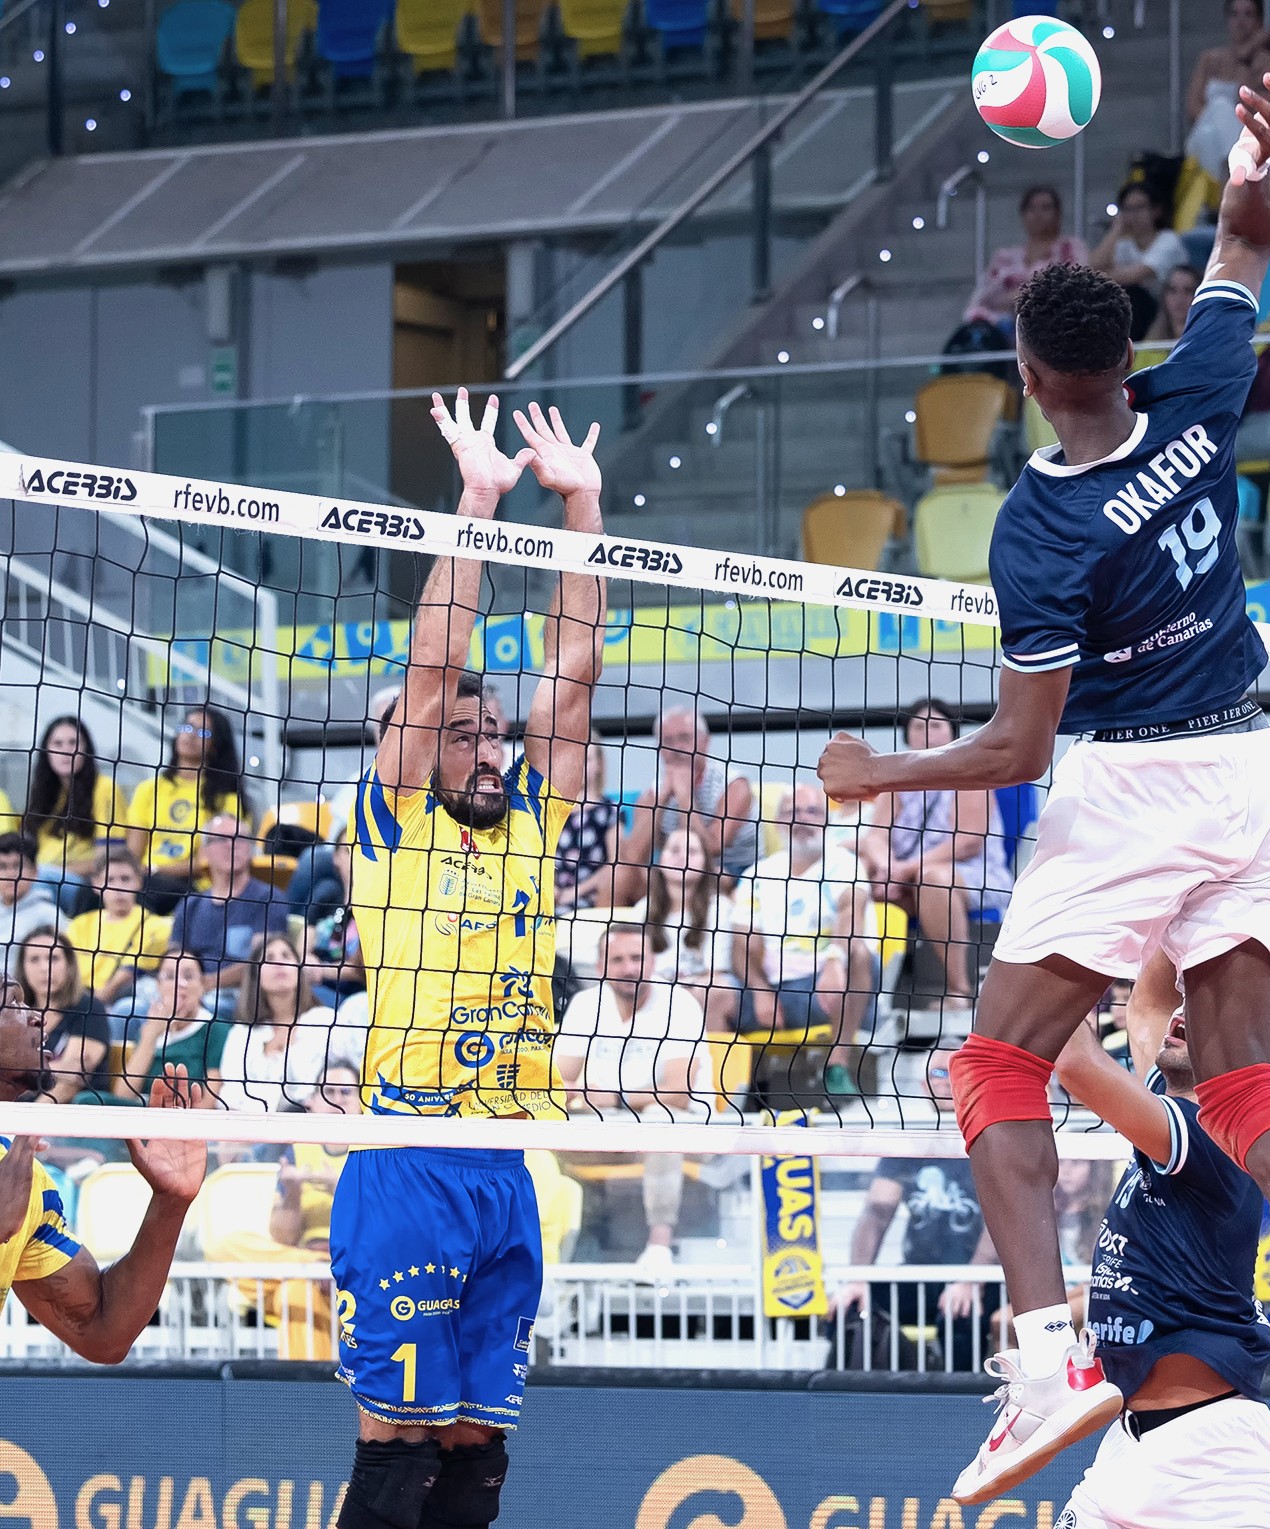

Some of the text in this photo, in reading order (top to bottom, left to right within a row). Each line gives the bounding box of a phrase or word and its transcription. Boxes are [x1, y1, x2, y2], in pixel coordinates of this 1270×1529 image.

[1103, 424, 1218, 535] OKAFOR
[26, 469, 137, 502] ACERBIS
[173, 486, 280, 522] rfevb.com
[320, 507, 425, 541] ACERBIS
[456, 523, 554, 559] rfevb.com
[588, 543, 683, 574] ACERBIS
[714, 558, 804, 592] rfevb.com
[836, 577, 924, 606] ACERBIS
[1158, 497, 1222, 592] 19
[1157, 617, 1213, 648] Canarias
[1138, 723, 1171, 738] ONE
[1188, 713, 1220, 729] PIER
[775, 1154, 813, 1242] UAS
[390, 1343, 417, 1402] 1
